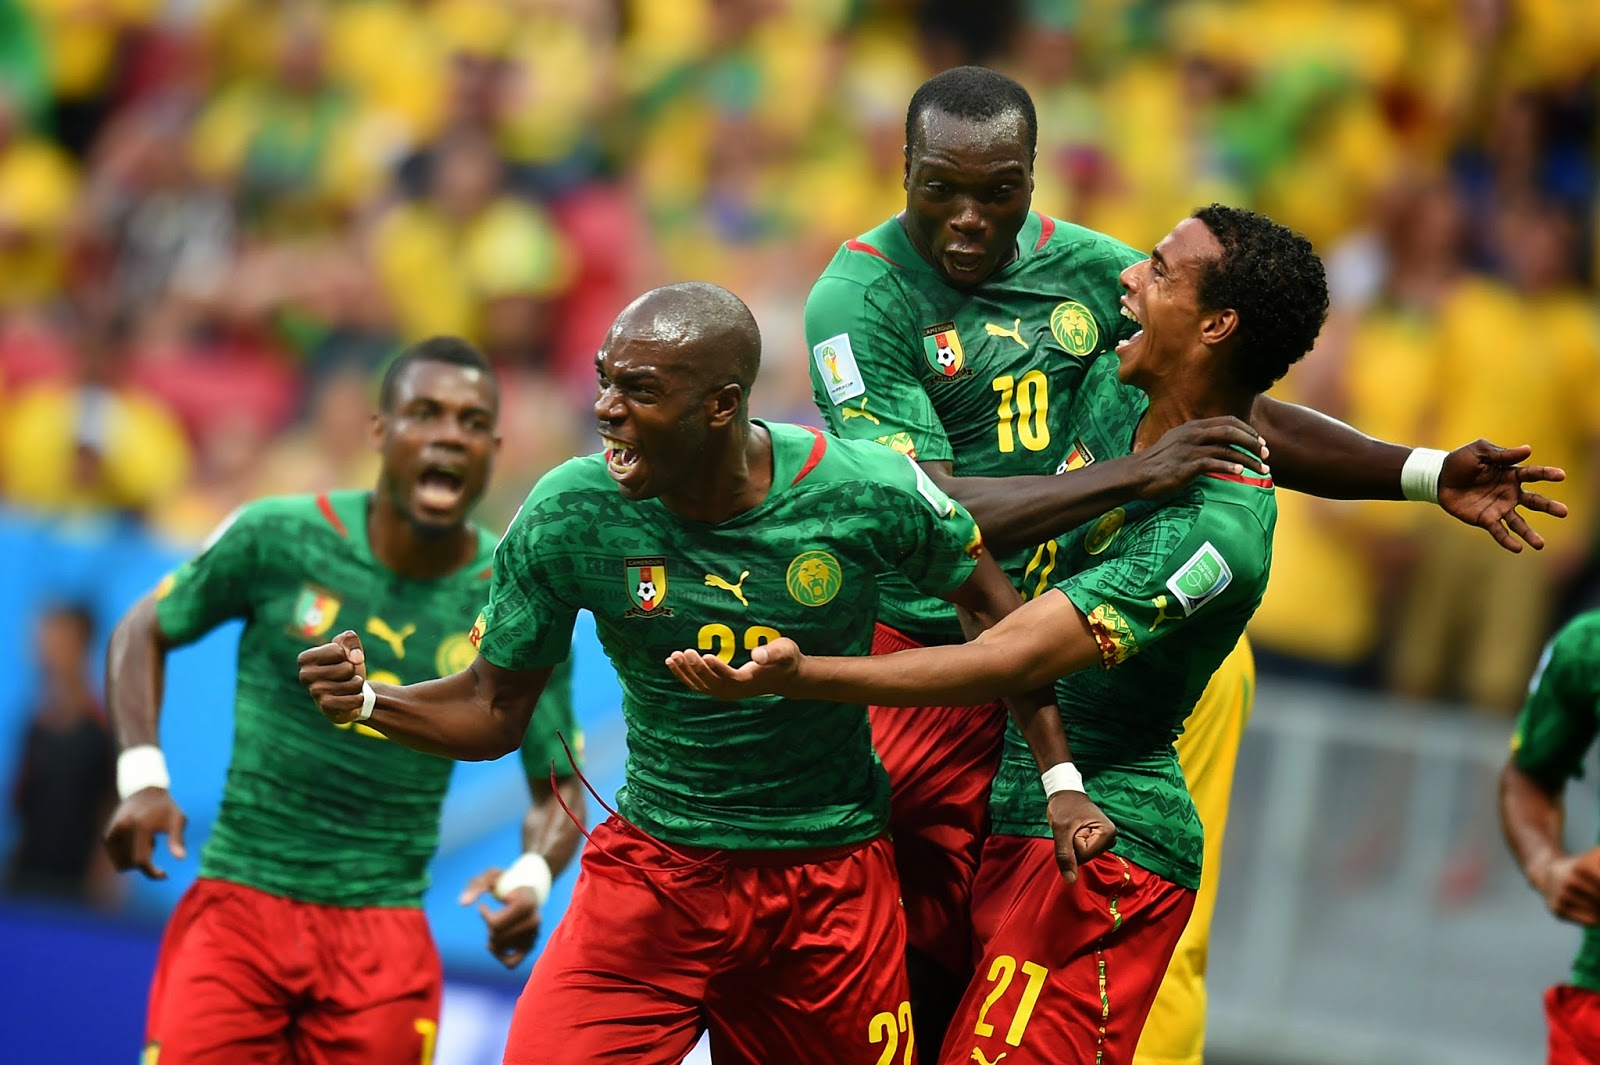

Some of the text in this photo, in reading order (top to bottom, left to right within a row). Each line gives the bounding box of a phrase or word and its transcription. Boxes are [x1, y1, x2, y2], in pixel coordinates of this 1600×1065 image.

[922, 324, 954, 336] CAMEROUN
[992, 370, 1050, 453] 10
[868, 1001, 914, 1065] 22
[974, 955, 1049, 1047] 21
